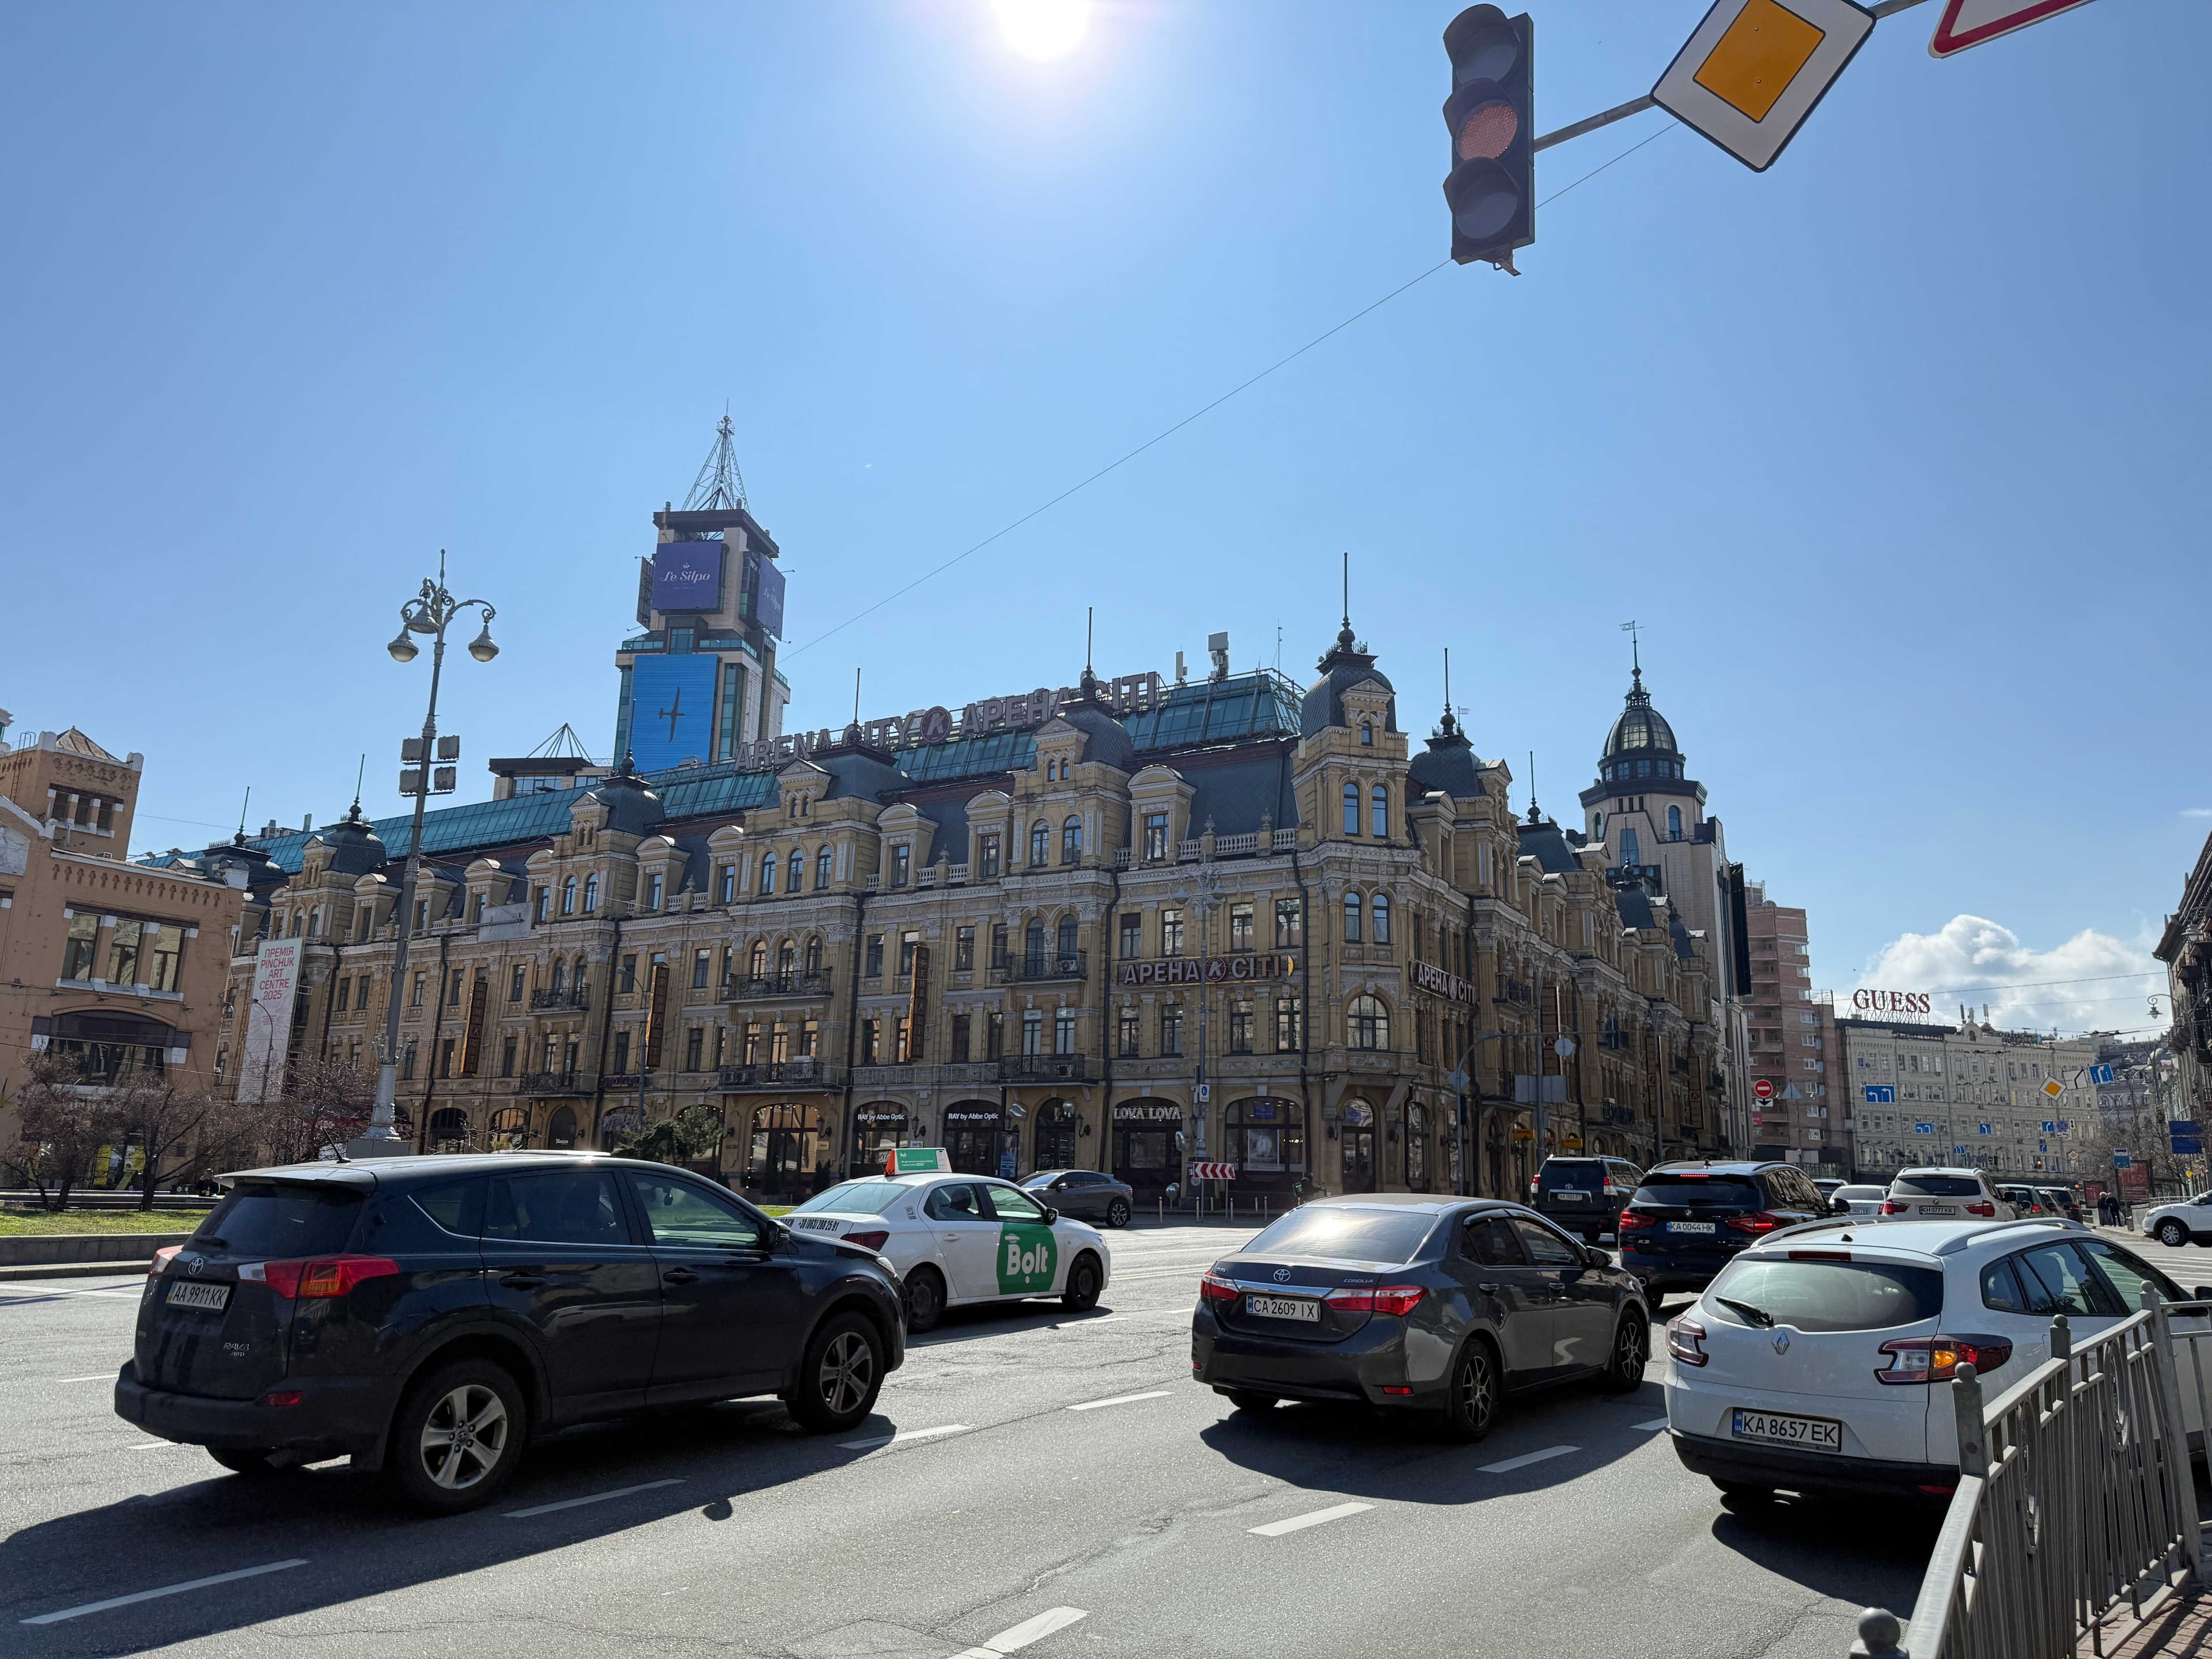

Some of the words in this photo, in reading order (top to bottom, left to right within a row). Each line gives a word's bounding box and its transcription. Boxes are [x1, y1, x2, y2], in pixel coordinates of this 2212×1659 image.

[660, 571, 678, 582] Le
[680, 570, 711, 584] Silpo
[733, 728, 831, 772] ARENA
[265, 946, 294, 958] ПРЕМІЯ
[260, 957, 295, 969] PINCHUK
[1123, 960, 1200, 984] АРЕНА
[1231, 956, 1281, 979] СІТІ
[268, 968, 285, 979] ART
[259, 978, 290, 990] CENTRE
[1418, 963, 1448, 995] АРЕНА
[1458, 980, 1475, 1003] СІТІ
[263, 990, 282, 1001] 2025
[1853, 988, 1931, 1013] GUESS
[1113, 1107, 1145, 1120] LOVA
[1149, 1107, 1181, 1120] LOVA
[1682, 1223, 1701, 1231] 0044
[1702, 1224, 1714, 1232] HK
[1006, 1243, 1048, 1283] Bolt
[1254, 1301, 1268, 1313] CA
[1271, 1302, 1296, 1316] 2609
[1743, 1415, 1766, 1434] KA
[1769, 1419, 1808, 1439] 8657
[1811, 1423, 1836, 1444] EK
